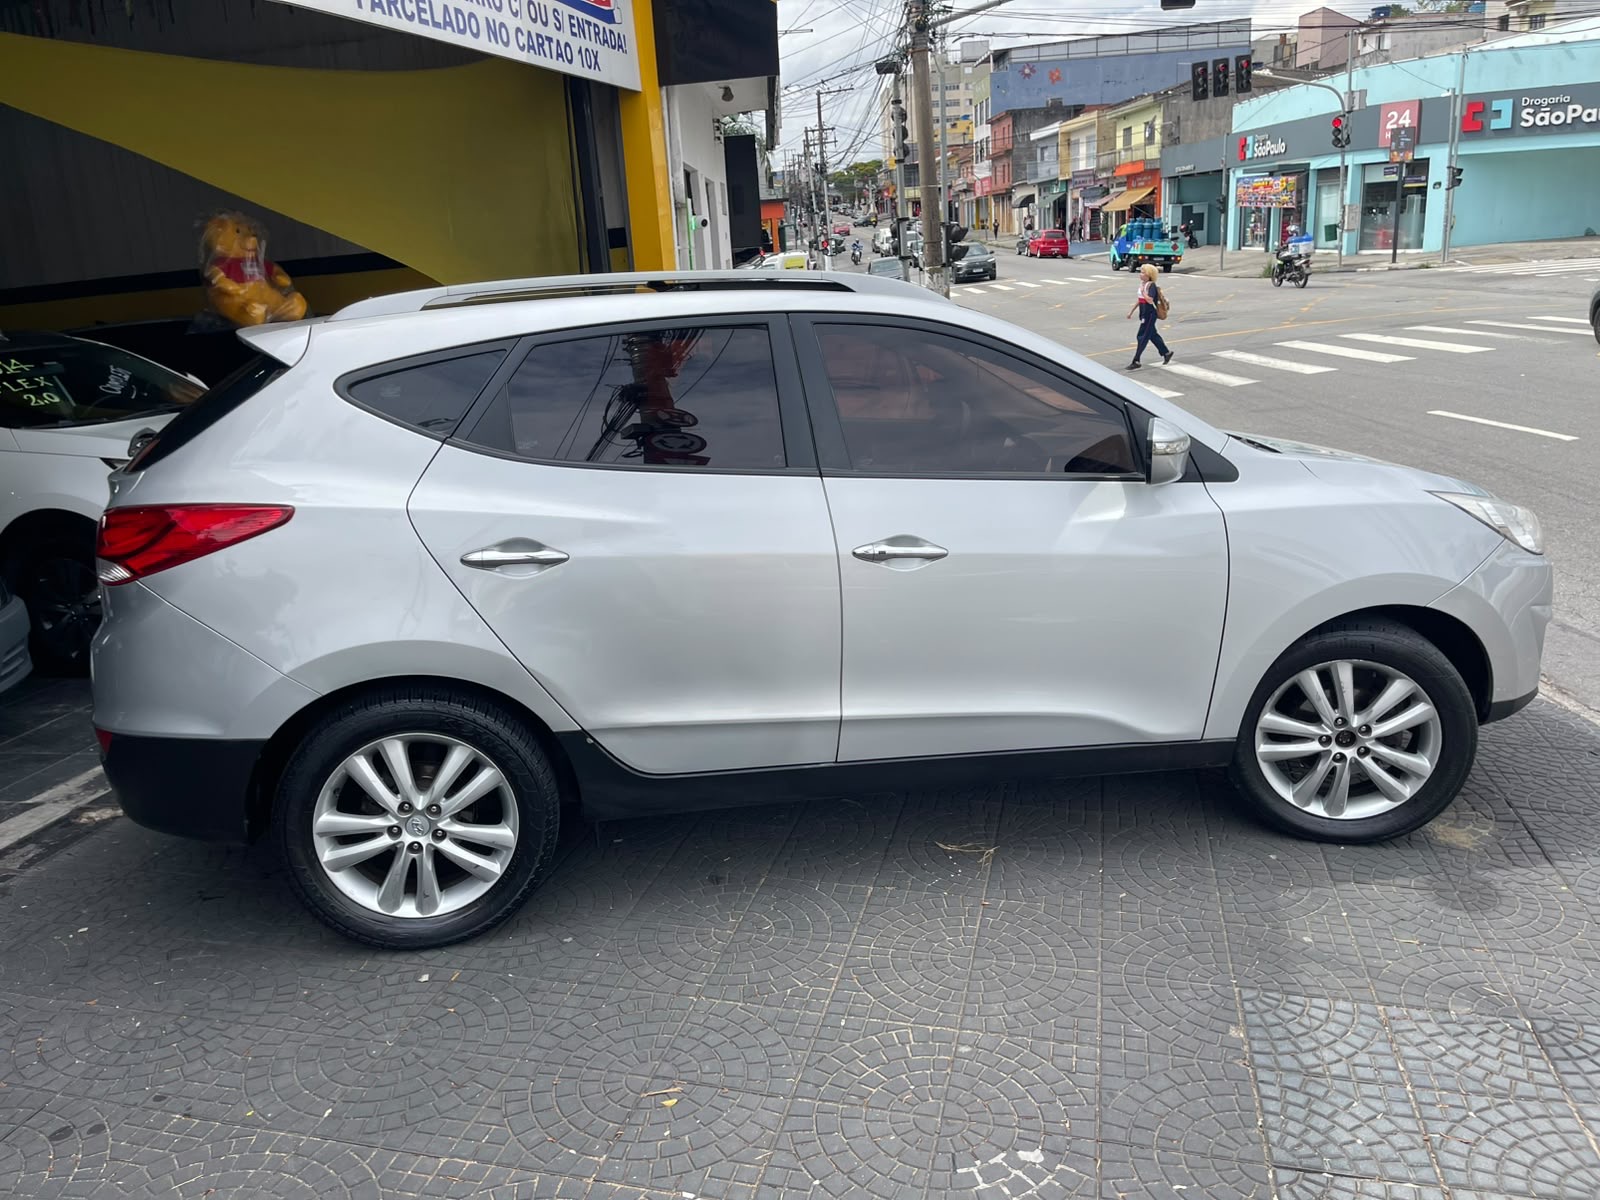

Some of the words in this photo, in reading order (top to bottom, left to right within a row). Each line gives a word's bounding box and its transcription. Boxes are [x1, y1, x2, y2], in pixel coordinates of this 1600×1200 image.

[527, 0, 549, 27] OU
[552, 7, 565, 33] S/
[567, 13, 628, 55] ENTRADA!
[485, 16, 511, 48] NO
[515, 26, 574, 65] CARTAO
[577, 45, 602, 72] 10X
[1521, 95, 1571, 107] Drogaria
[1386, 108, 1412, 130] 24
[1520, 104, 1600, 128] SãoPa
[1253, 137, 1286, 158] SãoPaulo
[0, 376, 54, 394] LEX
